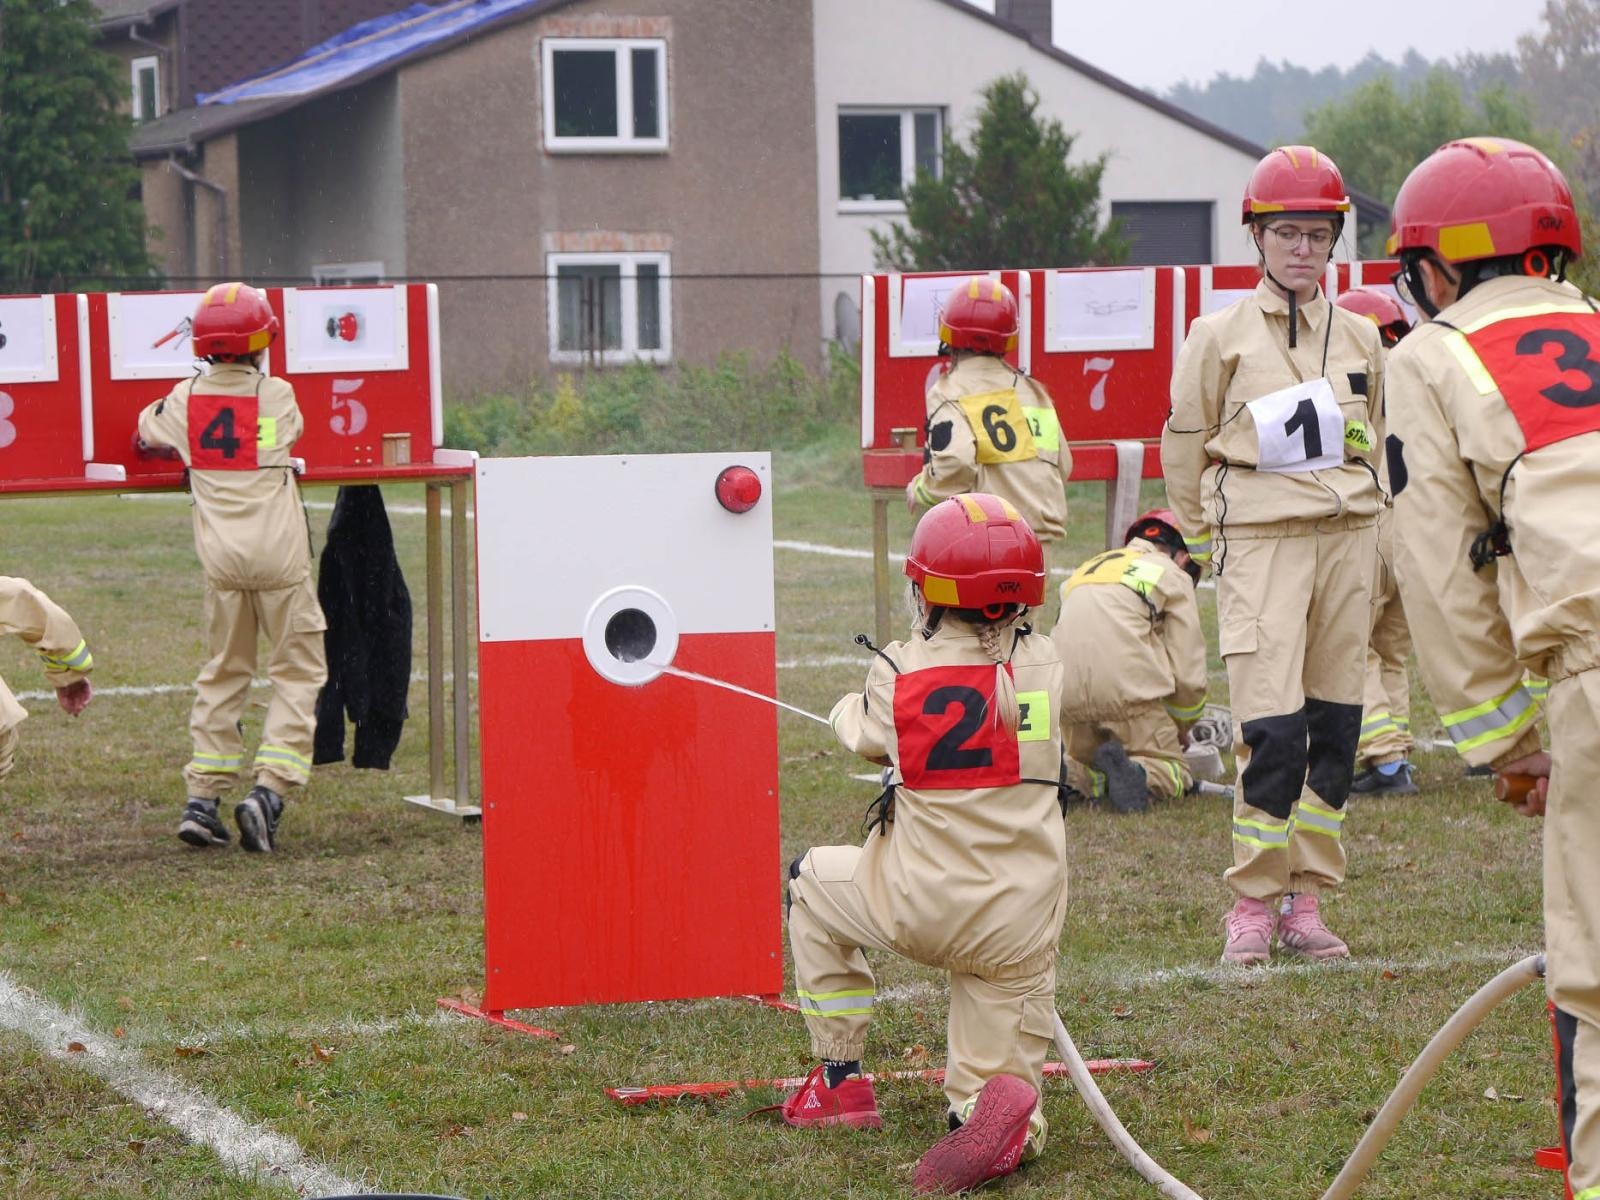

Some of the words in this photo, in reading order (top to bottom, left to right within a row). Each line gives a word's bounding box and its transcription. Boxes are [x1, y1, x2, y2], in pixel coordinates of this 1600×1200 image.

[1083, 357, 1114, 410] 7
[1515, 328, 1600, 409] 3
[200, 407, 241, 459] 4
[329, 378, 368, 436] 5
[982, 404, 1017, 453] 6
[1284, 398, 1323, 460] 1
[922, 685, 993, 771] 2
